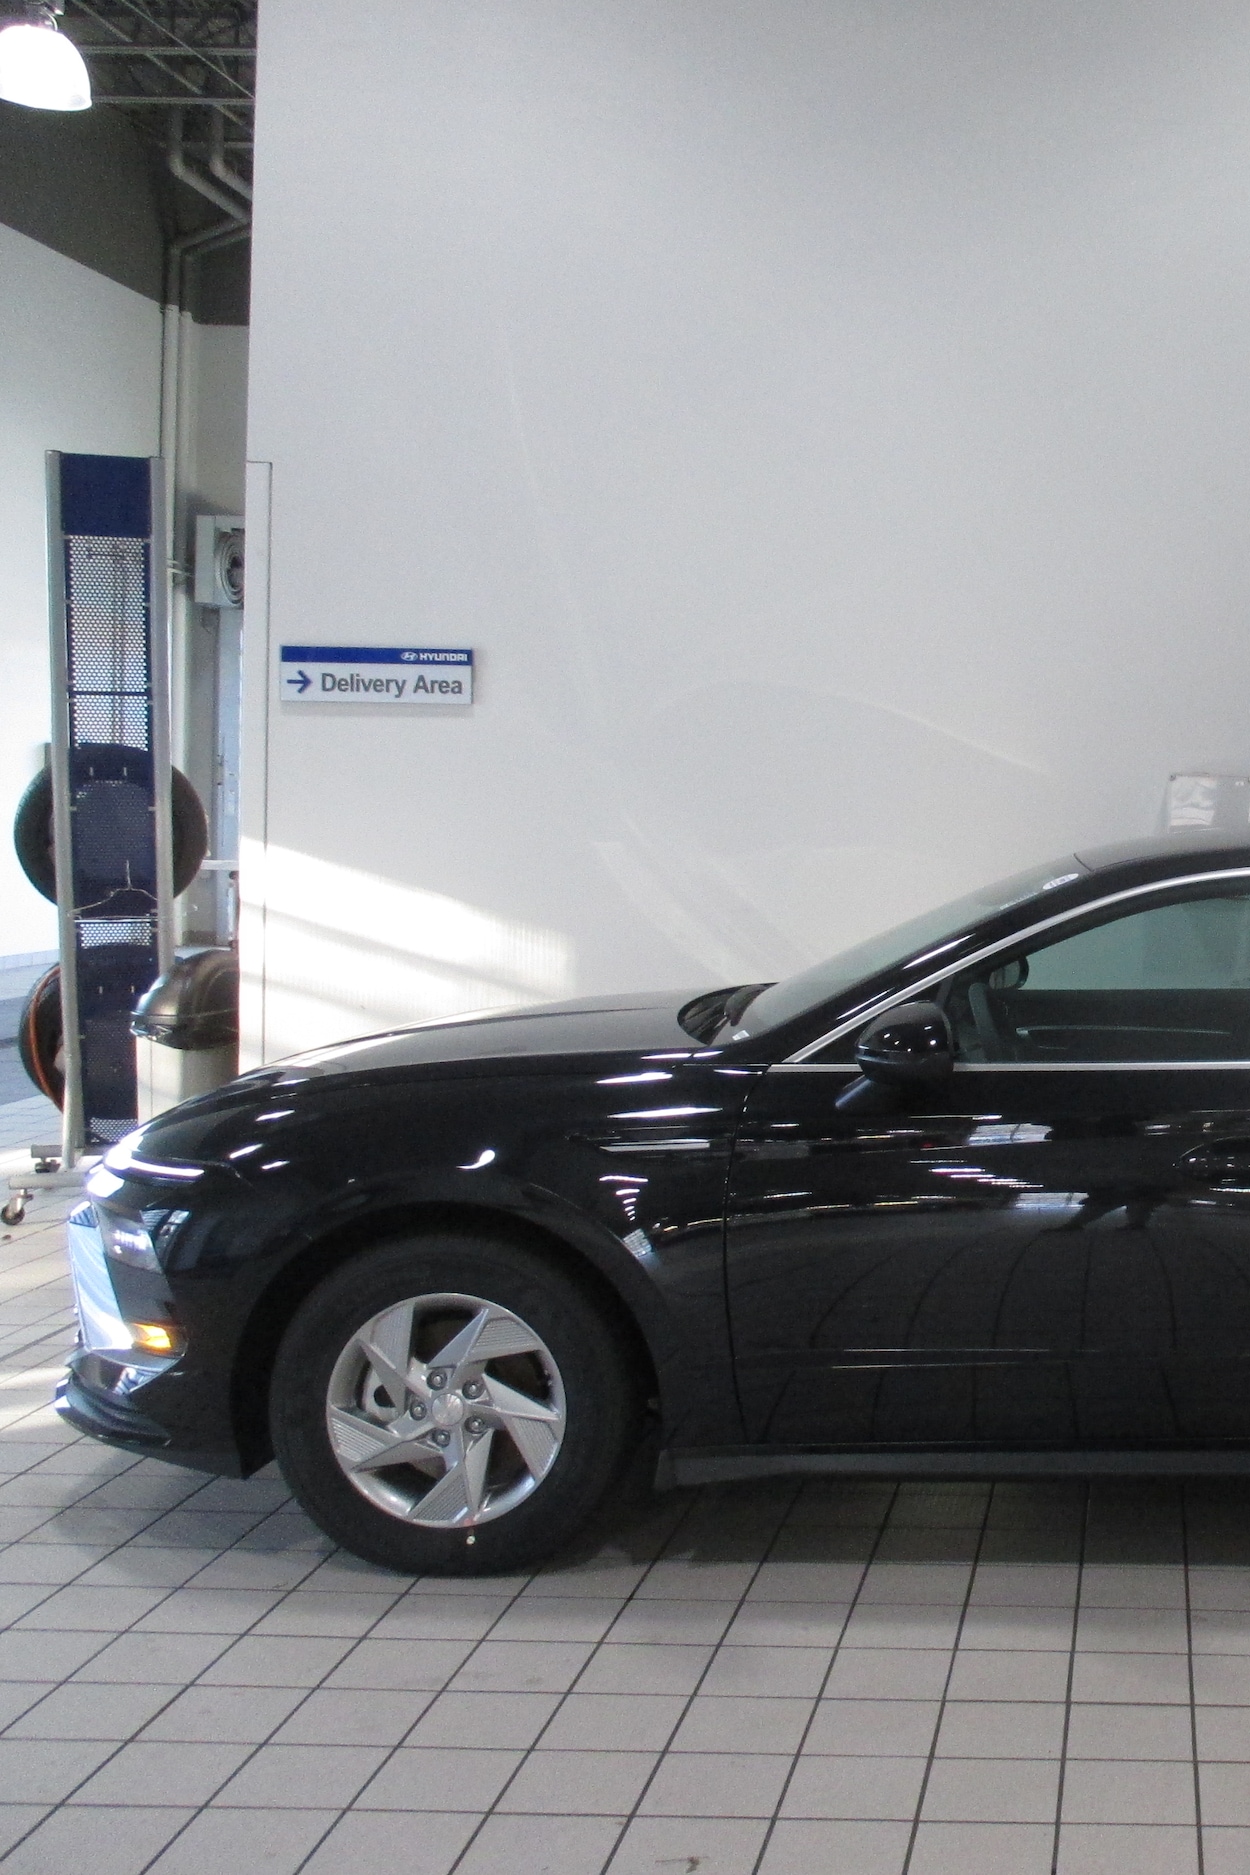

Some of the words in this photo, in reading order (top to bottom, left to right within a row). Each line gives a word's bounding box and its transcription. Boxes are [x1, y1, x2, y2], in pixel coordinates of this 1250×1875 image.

[420, 652, 467, 662] HYUNDAI
[321, 673, 406, 698] Delivery
[413, 675, 463, 695] Area
